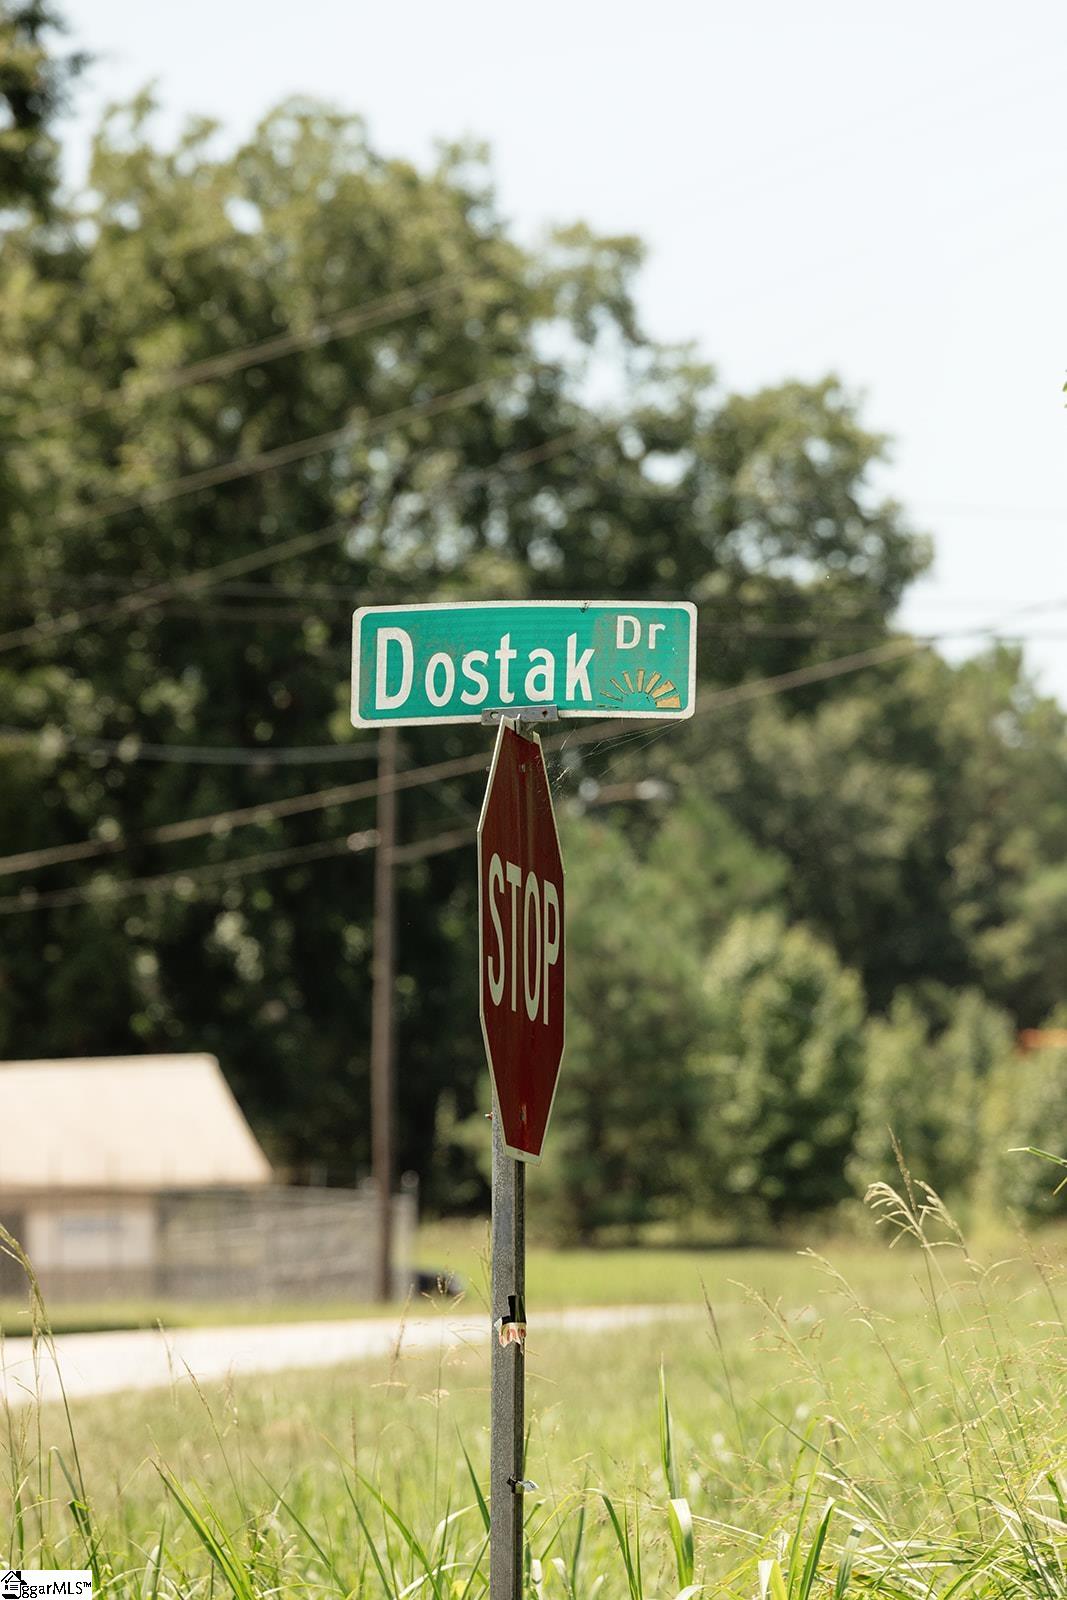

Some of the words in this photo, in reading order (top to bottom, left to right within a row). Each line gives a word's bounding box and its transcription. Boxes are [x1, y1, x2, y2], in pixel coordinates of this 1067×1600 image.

[375, 627, 596, 710] Dostak
[616, 615, 666, 650] Dr
[487, 853, 560, 1026] STOP
